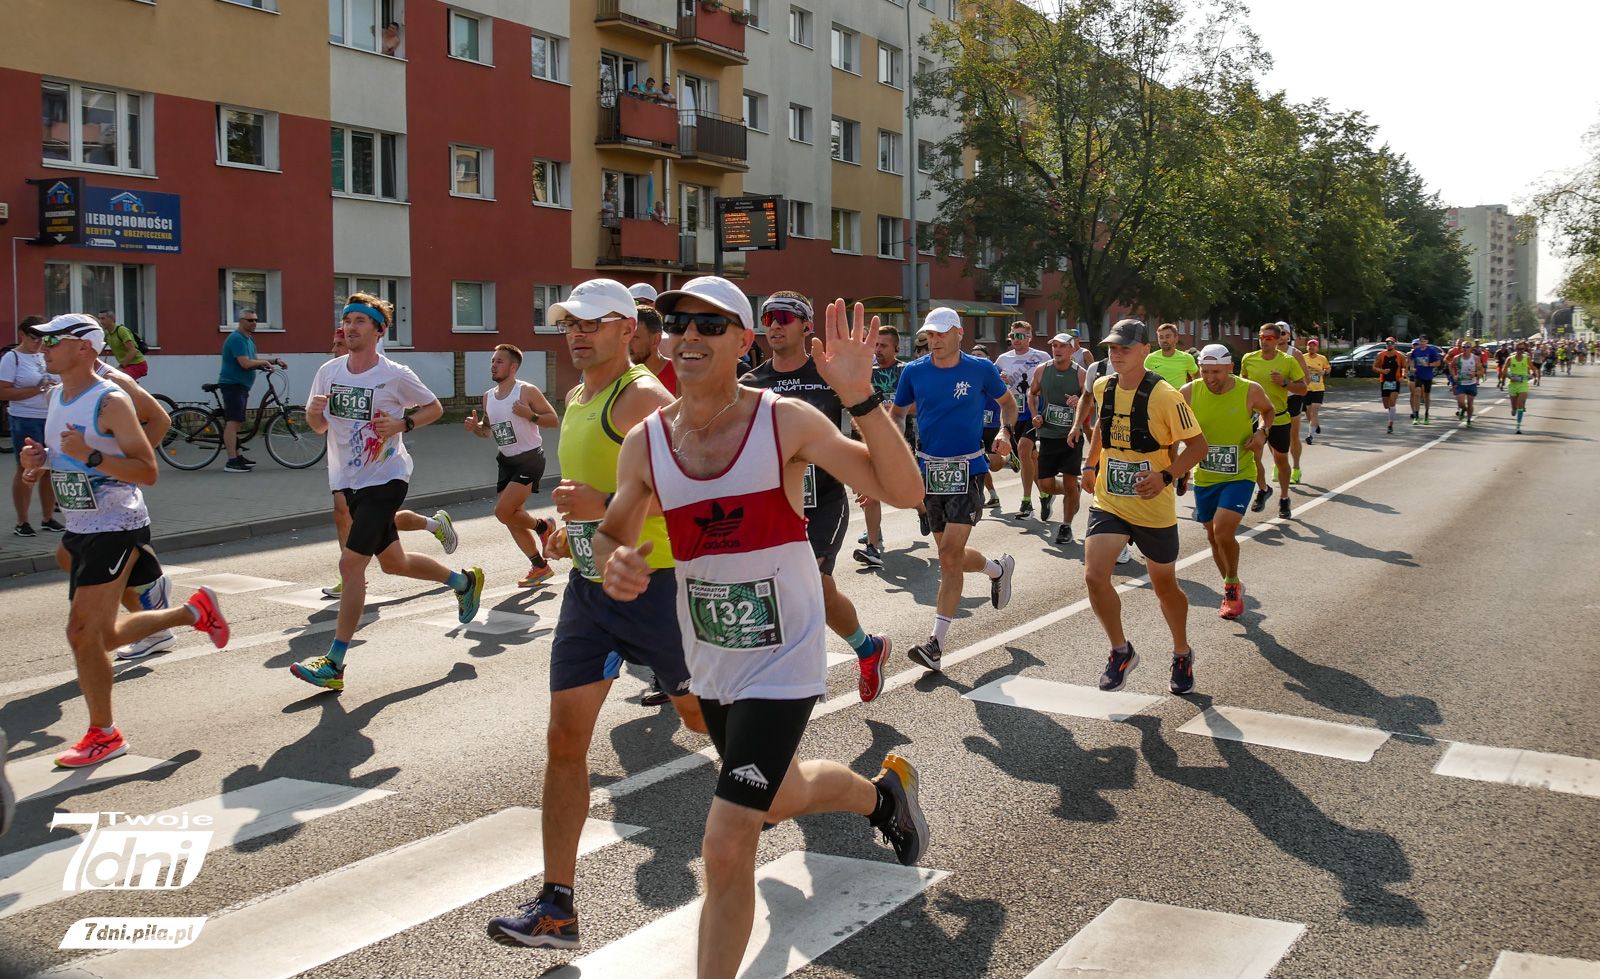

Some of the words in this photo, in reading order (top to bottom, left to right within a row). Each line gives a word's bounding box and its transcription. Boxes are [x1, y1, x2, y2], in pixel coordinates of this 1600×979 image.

[123, 229, 172, 240] UBEZPIECZENIA
[777, 378, 800, 386] TEAM
[335, 393, 366, 409] 1516
[932, 470, 962, 482] 1379
[56, 481, 83, 496] 1037
[573, 536, 593, 557] 88
[703, 539, 741, 549] adidas
[706, 600, 756, 626] 132
